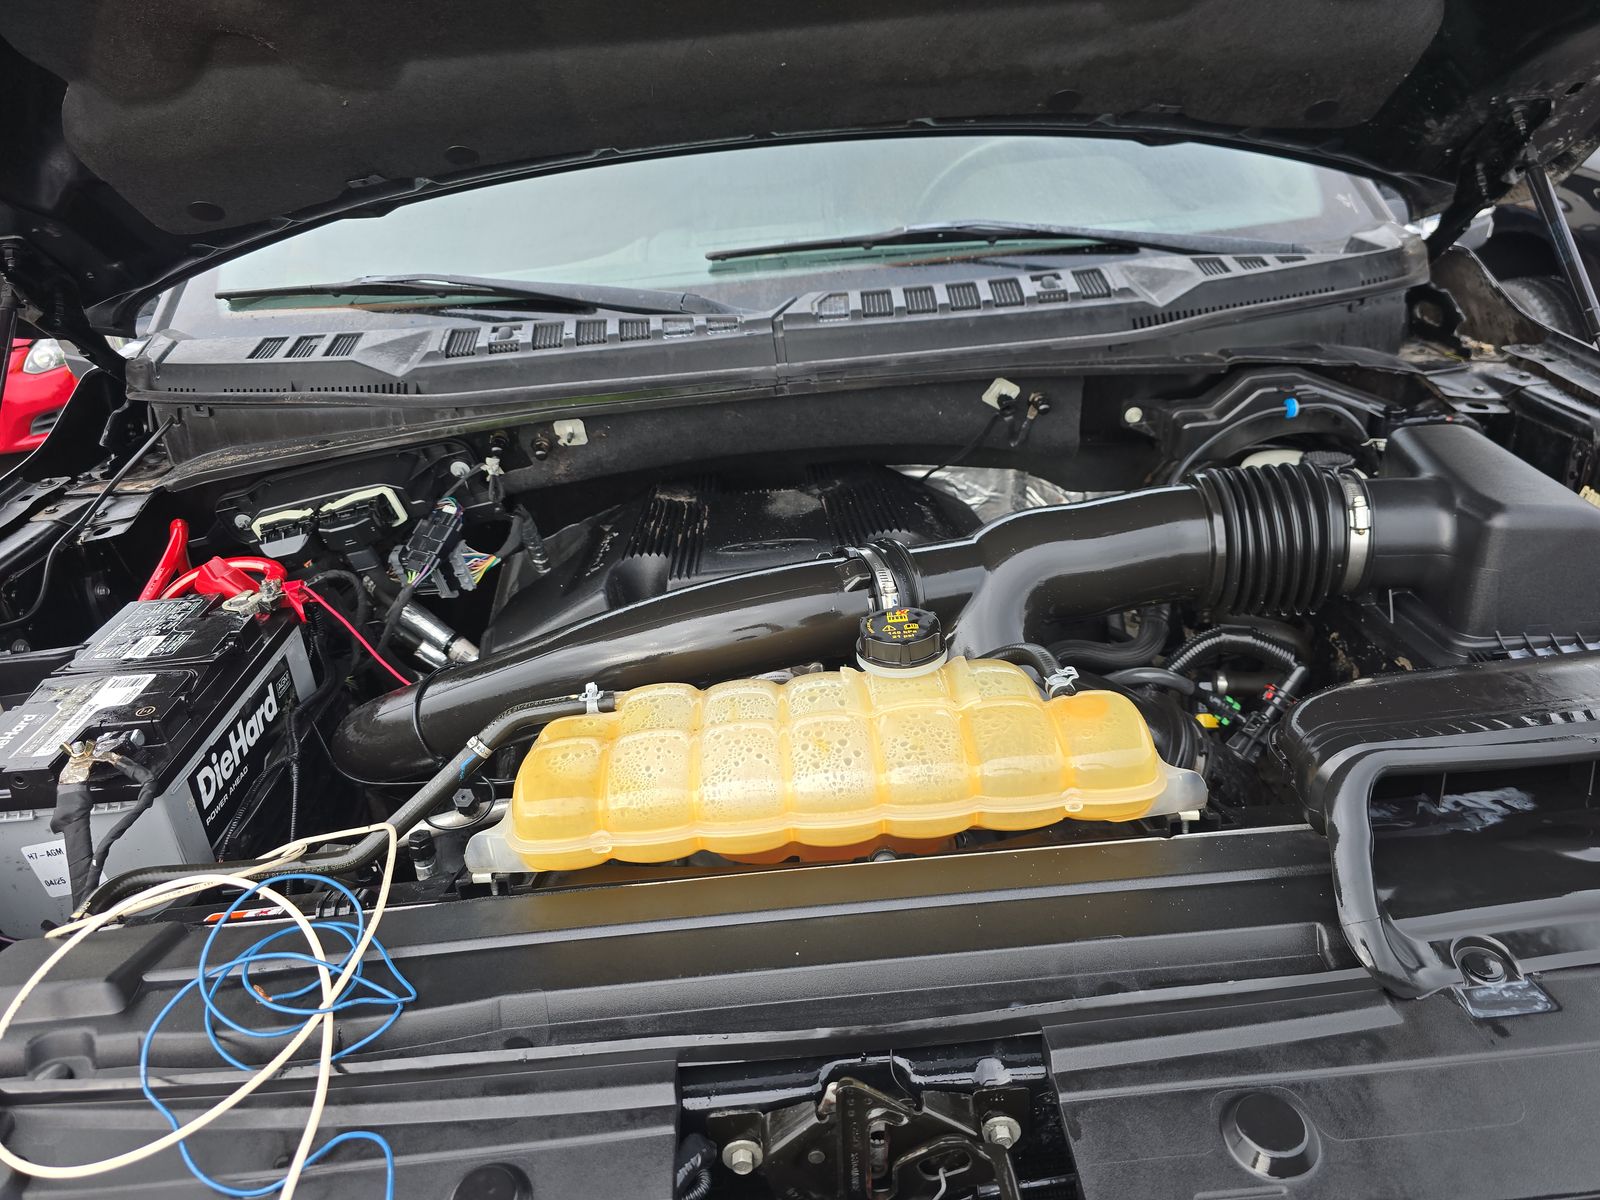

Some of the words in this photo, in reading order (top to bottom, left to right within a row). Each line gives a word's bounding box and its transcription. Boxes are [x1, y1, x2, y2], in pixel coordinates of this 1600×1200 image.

[0, 714, 38, 750] eHard
[196, 681, 278, 810] DieHard
[205, 793, 229, 826] POWER
[228, 765, 250, 796] AHEAD
